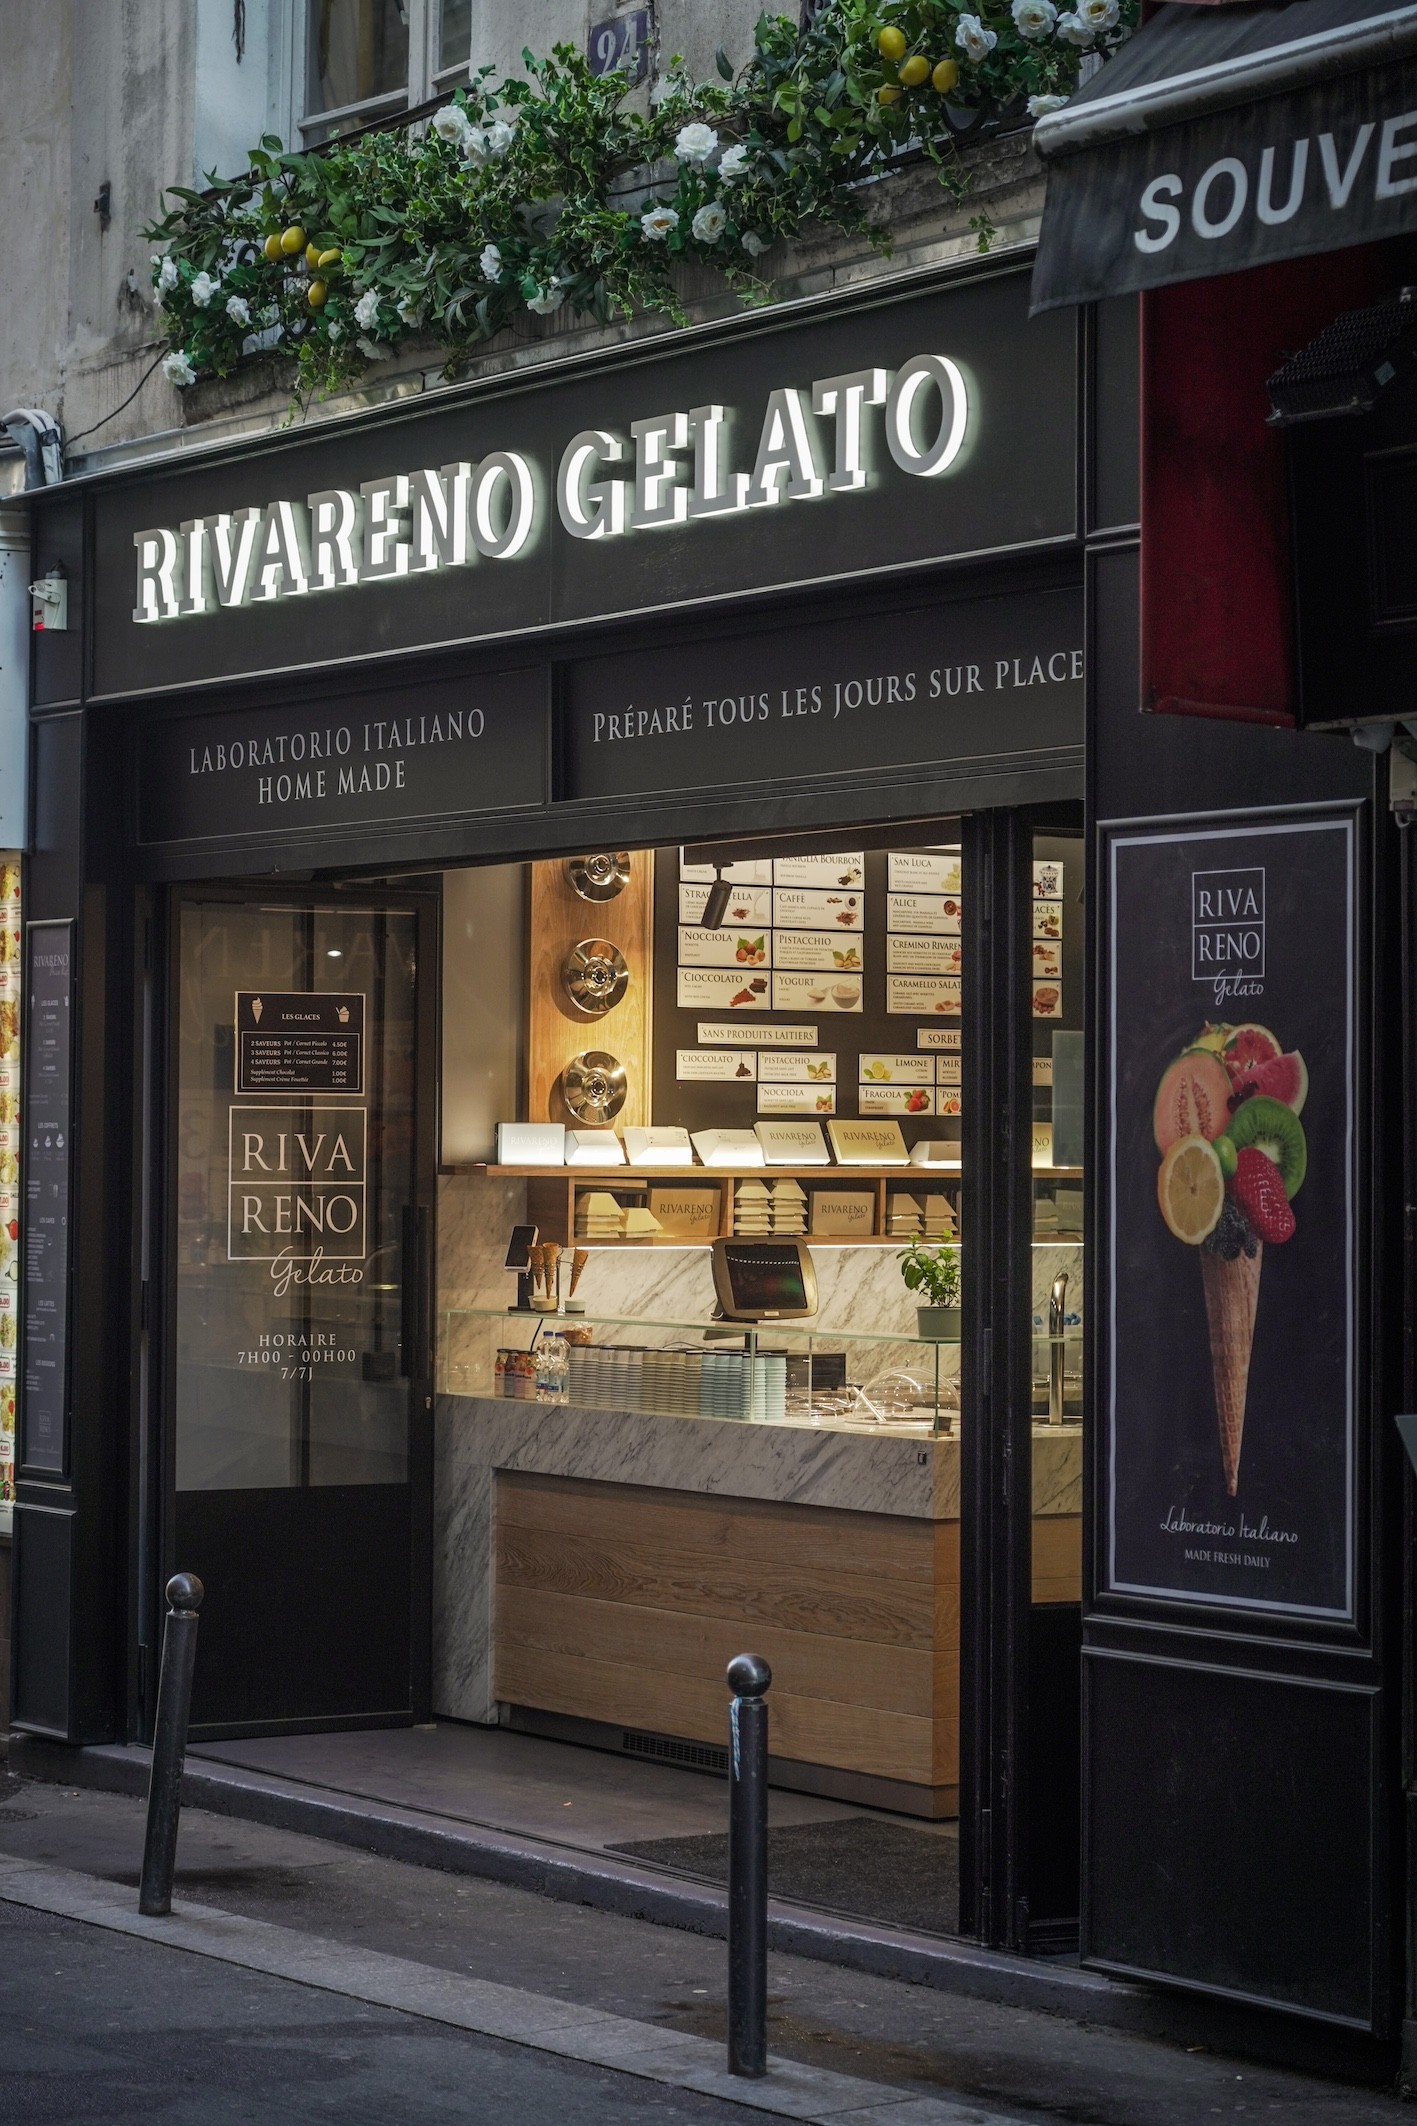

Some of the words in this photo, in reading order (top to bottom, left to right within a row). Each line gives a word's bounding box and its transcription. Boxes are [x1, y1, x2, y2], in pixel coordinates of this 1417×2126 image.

[1134, 110, 1417, 253] SOUVE
[132, 451, 534, 623] RIVARENO
[557, 354, 968, 539] GELATO
[593, 696, 693, 742] PRÉPARÉ
[703, 693, 769, 728] TOUS
[781, 685, 822, 718] LES
[834, 672, 916, 719] JOURS
[929, 664, 984, 698] SUR
[995, 650, 1084, 690] PLACE
[190, 727, 351, 774] LABORATORIO
[363, 708, 485, 751] ITALIANO
[258, 770, 326, 804] HOME
[337, 760, 406, 796] MADE
[894, 857, 909, 867] SAN
[911, 858, 932, 868] LUCA
[892, 898, 917, 907] ALICE
[1199, 887, 1259, 918] RIVA
[684, 932, 732, 943] NOCCIOLA
[779, 935, 831, 946] PISTACCHIO
[892, 940, 930, 950] CREMINO
[1199, 931, 1260, 962] RENO
[684, 972, 743, 984] CIOCCOLATO
[779, 976, 815, 987] YOGURT
[892, 979, 937, 989] CARAMELLO
[1213, 968, 1264, 1006] Gelato
[702, 1029, 725, 1039] SANS
[727, 1030, 773, 1040] PRODUITS
[775, 1031, 814, 1041] LAITIERS
[927, 1034, 961, 1044] SORBE
[682, 1055, 733, 1063] CIOCCOLATO
[764, 1057, 810, 1065] PISTACCHIO
[895, 1058, 928, 1068] LIMONE
[942, 1059, 960, 1068] MIR
[763, 1088, 804, 1097] NOCCIOLA
[864, 1089, 902, 1098] FRAGOLA
[769, 1132, 816, 1141] RIVARENO
[843, 1132, 896, 1141] RIVARENO
[241, 1133, 356, 1172] RIVA
[659, 1203, 713, 1214] RIVARENO
[821, 1204, 868, 1214] RIVARENO
[241, 1195, 358, 1234] RENO
[270, 1245, 364, 1297] Gelato
[259, 1333, 337, 1347] HORAIRE
[237, 1351, 281, 1364] 7H00
[302, 1349, 356, 1363] 00H00
[280, 1367, 314, 1381] 7/7J
[1160, 1505, 1235, 1537] Laboratorio
[1239, 1513, 1298, 1543] Italiano
[1184, 1549, 1211, 1562] MADE
[1213, 1551, 1241, 1565] FRESH
[1243, 1555, 1271, 1568] DAILY
